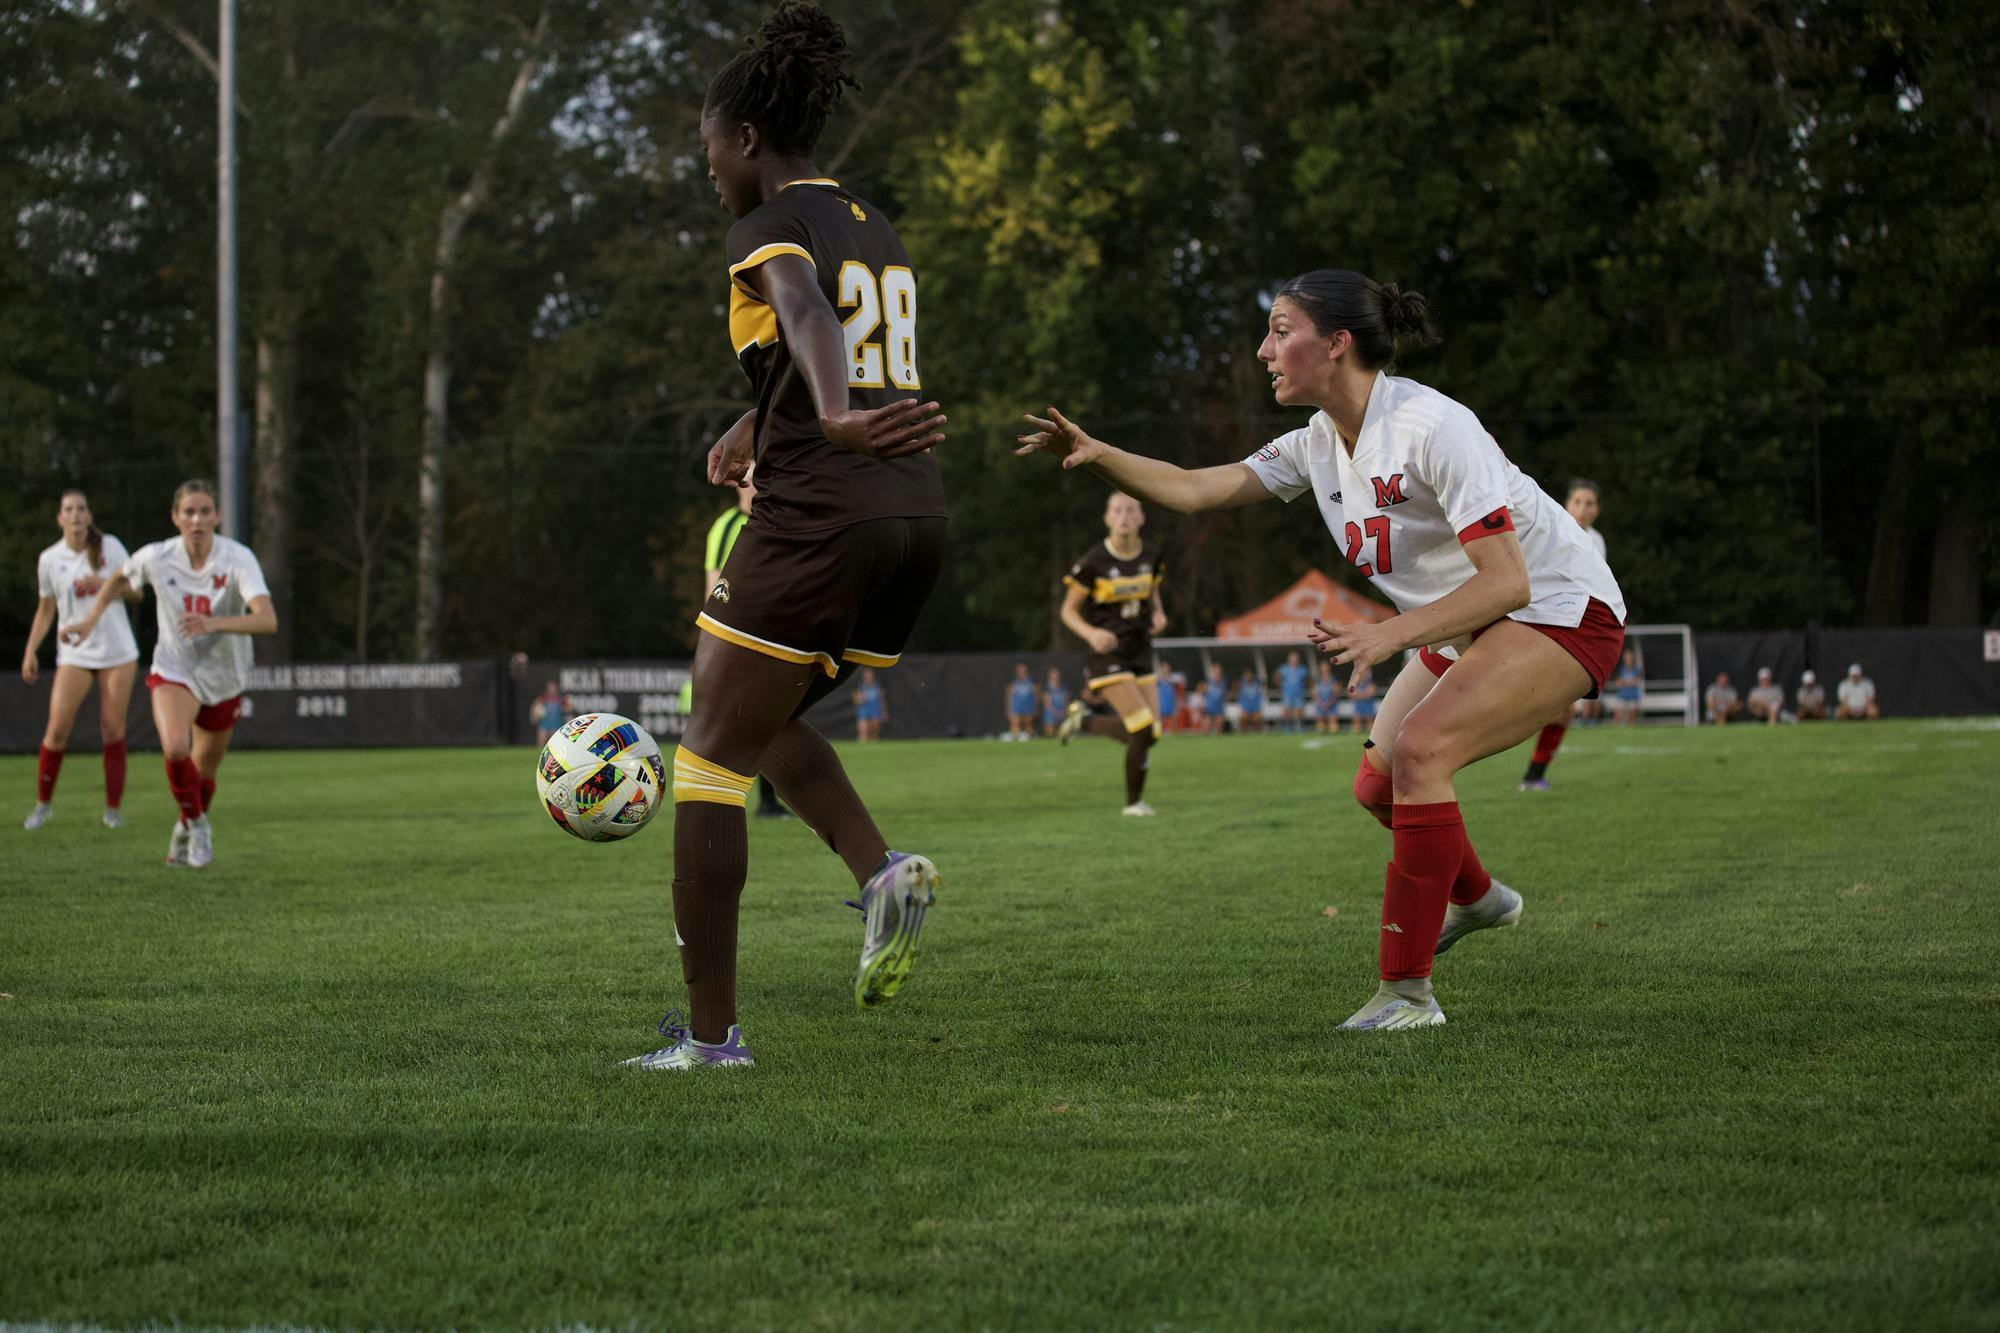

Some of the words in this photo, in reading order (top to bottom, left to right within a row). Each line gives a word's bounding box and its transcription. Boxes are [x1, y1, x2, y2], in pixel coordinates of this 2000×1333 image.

[837, 260, 921, 391] 28
[1371, 474, 1410, 508] M
[1345, 515, 1392, 577] 27
